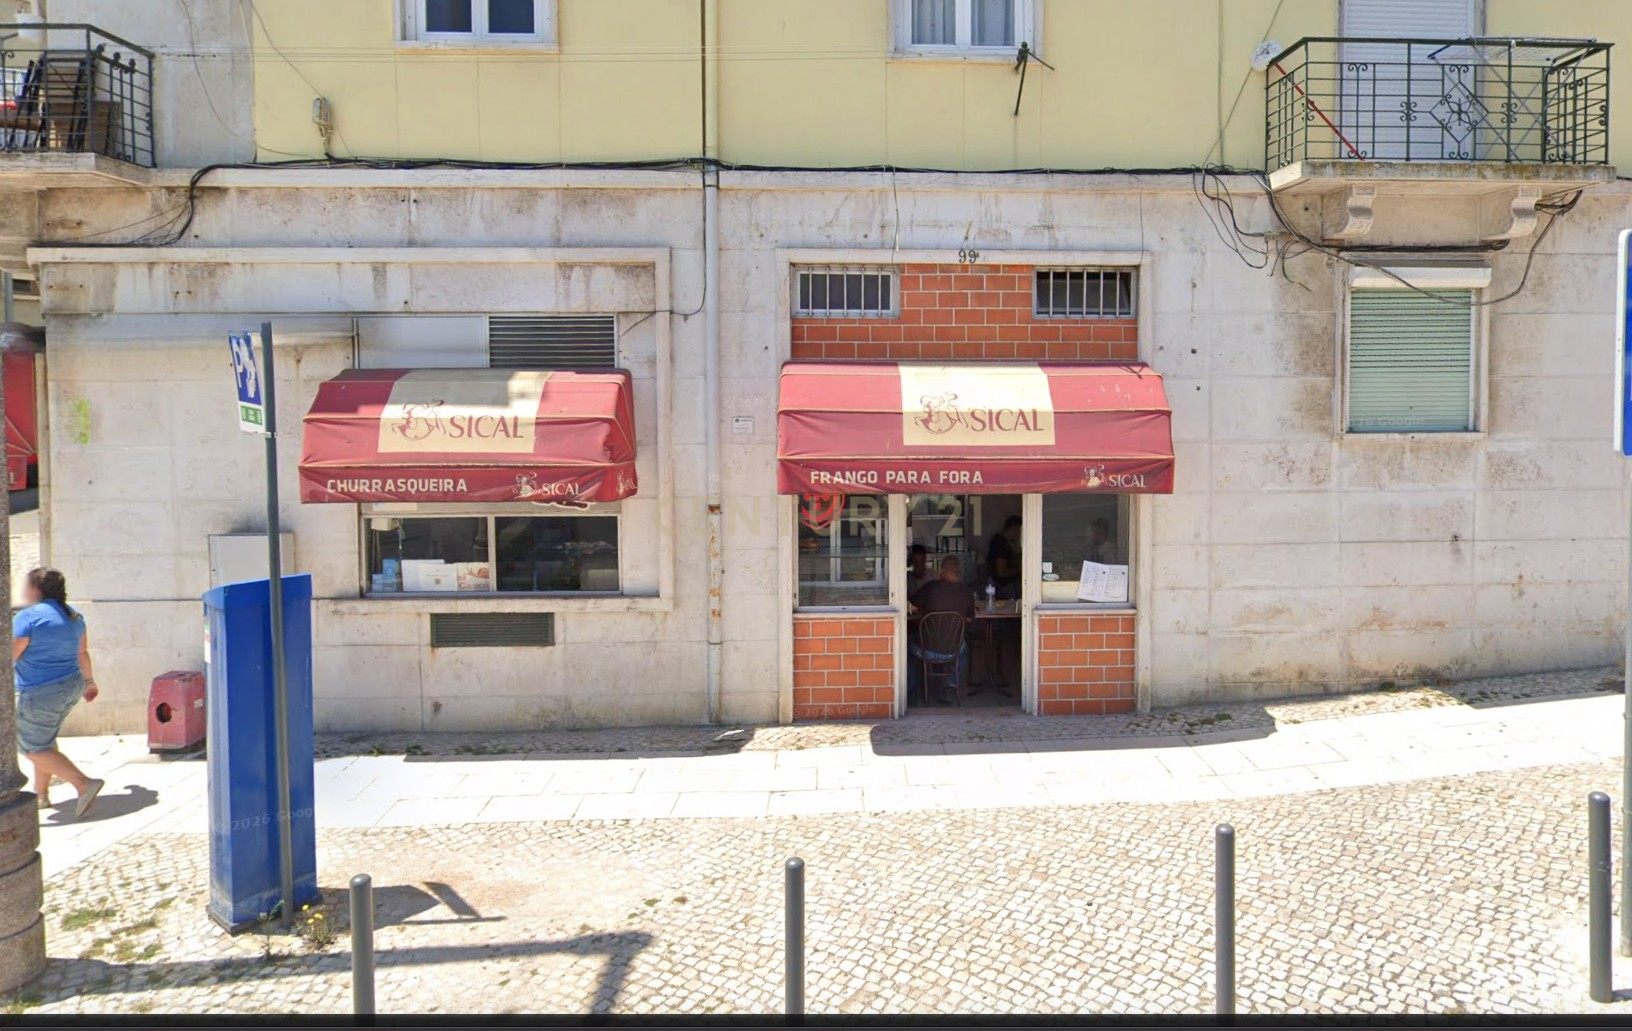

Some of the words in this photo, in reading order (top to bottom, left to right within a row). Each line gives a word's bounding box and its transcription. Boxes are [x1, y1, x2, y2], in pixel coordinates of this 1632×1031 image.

[449, 415, 524, 439] SICAL
[970, 408, 1045, 432] SICAL
[810, 470, 878, 485] FRANGO
[885, 470, 932, 484] PARA
[939, 470, 984, 484] FORA
[1108, 474, 1147, 488] SICAL
[327, 478, 468, 494] CHURRASQUEIRA
